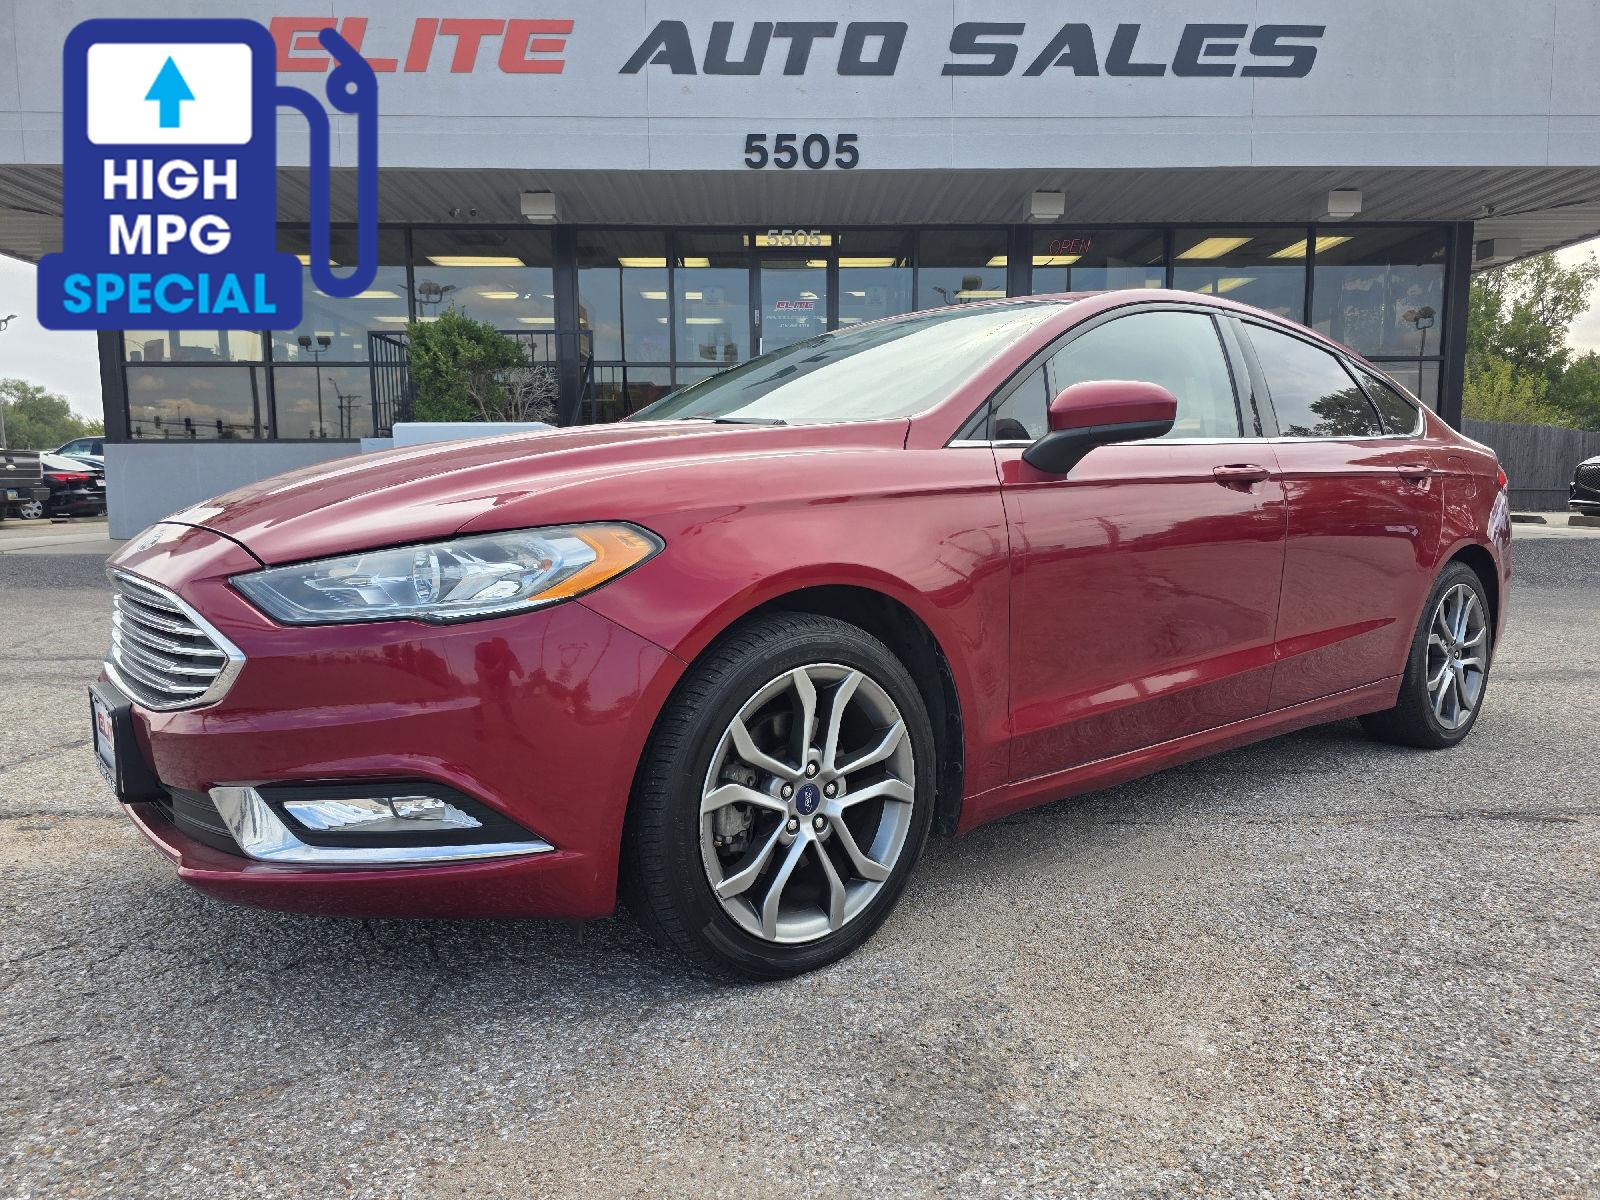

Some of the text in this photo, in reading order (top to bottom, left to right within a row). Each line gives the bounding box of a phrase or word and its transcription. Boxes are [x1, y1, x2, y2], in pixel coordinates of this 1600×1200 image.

[269, 17, 1327, 78] ELITE AUTO SALES
[744, 133, 860, 170] 5505
[766, 229, 821, 246] 5505
[1049, 238, 1092, 256] OPEN
